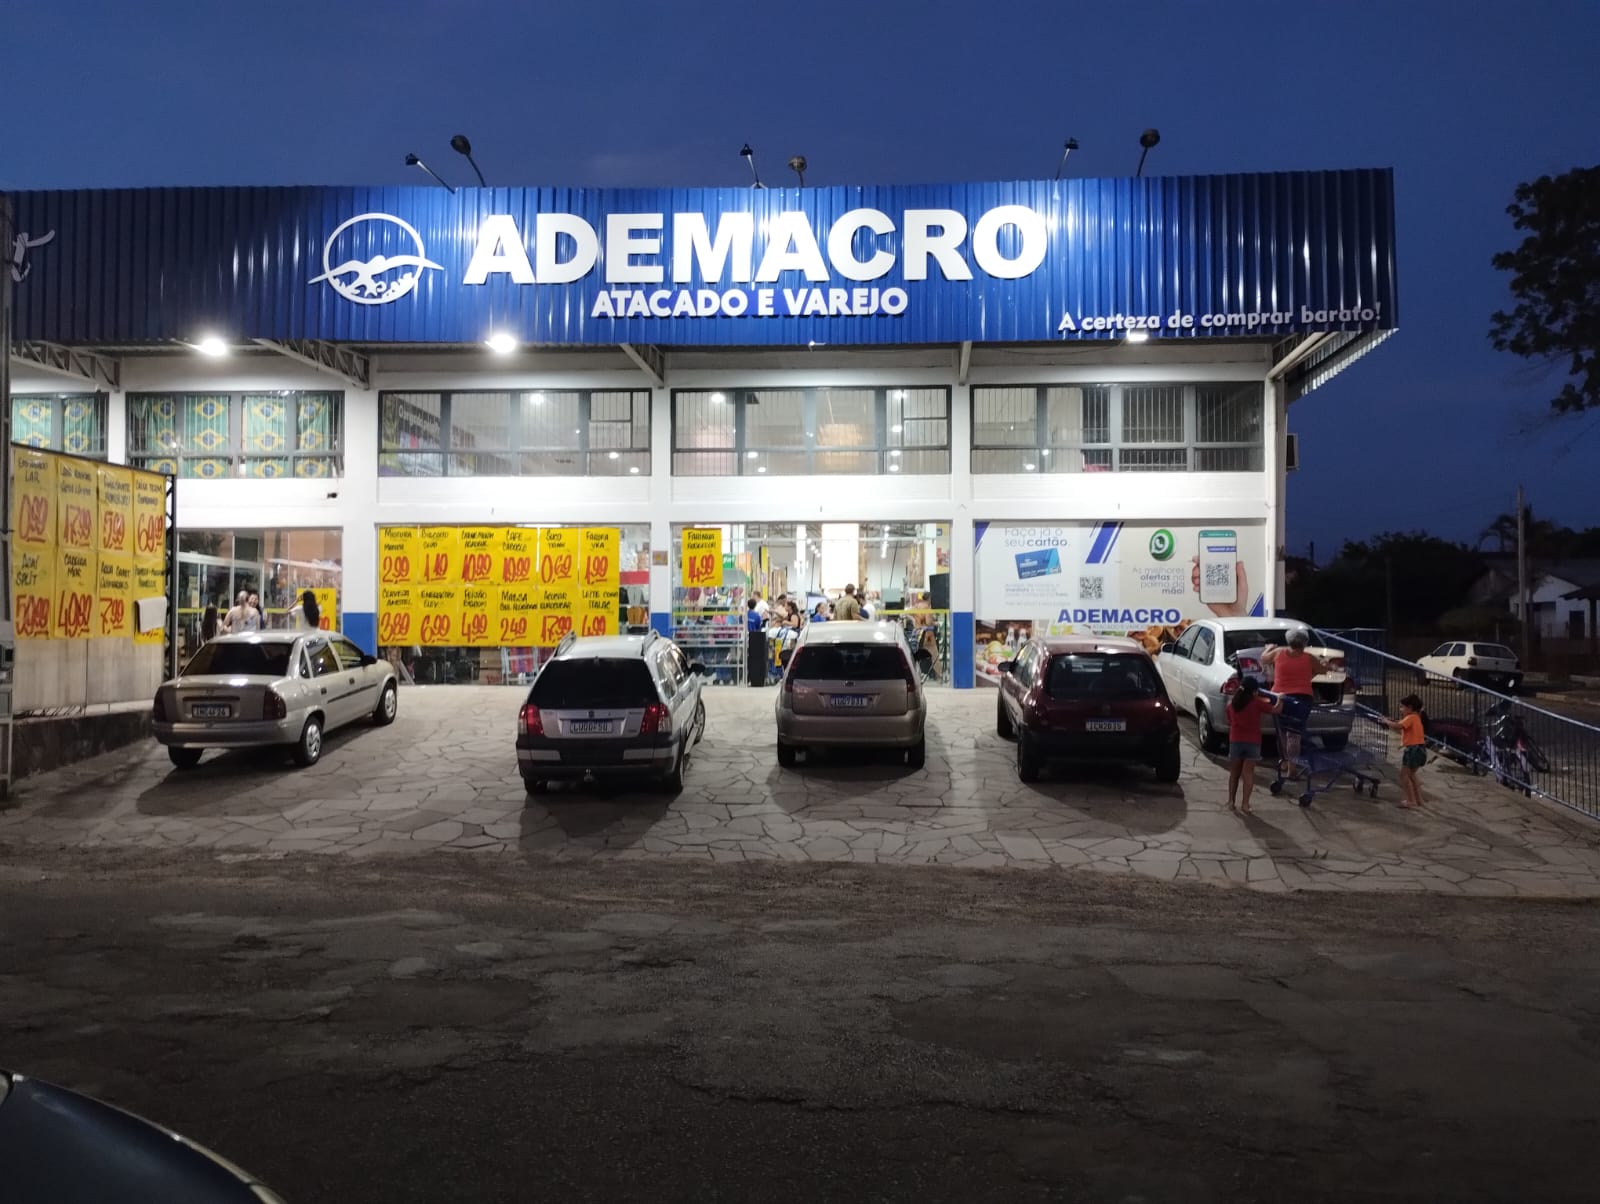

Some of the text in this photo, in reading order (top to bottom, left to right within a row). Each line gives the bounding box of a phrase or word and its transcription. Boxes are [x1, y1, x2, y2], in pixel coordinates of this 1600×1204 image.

[462, 204, 1048, 284] ADEMACRO
[591, 287, 908, 317] ATACADO E VAREJO
[1057, 301, 1382, 330] A certeza de comprar barato!
[1005, 538, 1025, 547] seu
[382, 555, 411, 584] 2,99
[1144, 566, 1185, 574] melhores
[420, 613, 451, 644] 6,99
[461, 611, 488, 643] 4,99
[581, 613, 607, 637] 499
[1057, 608, 1181, 623] ADEMACRO
